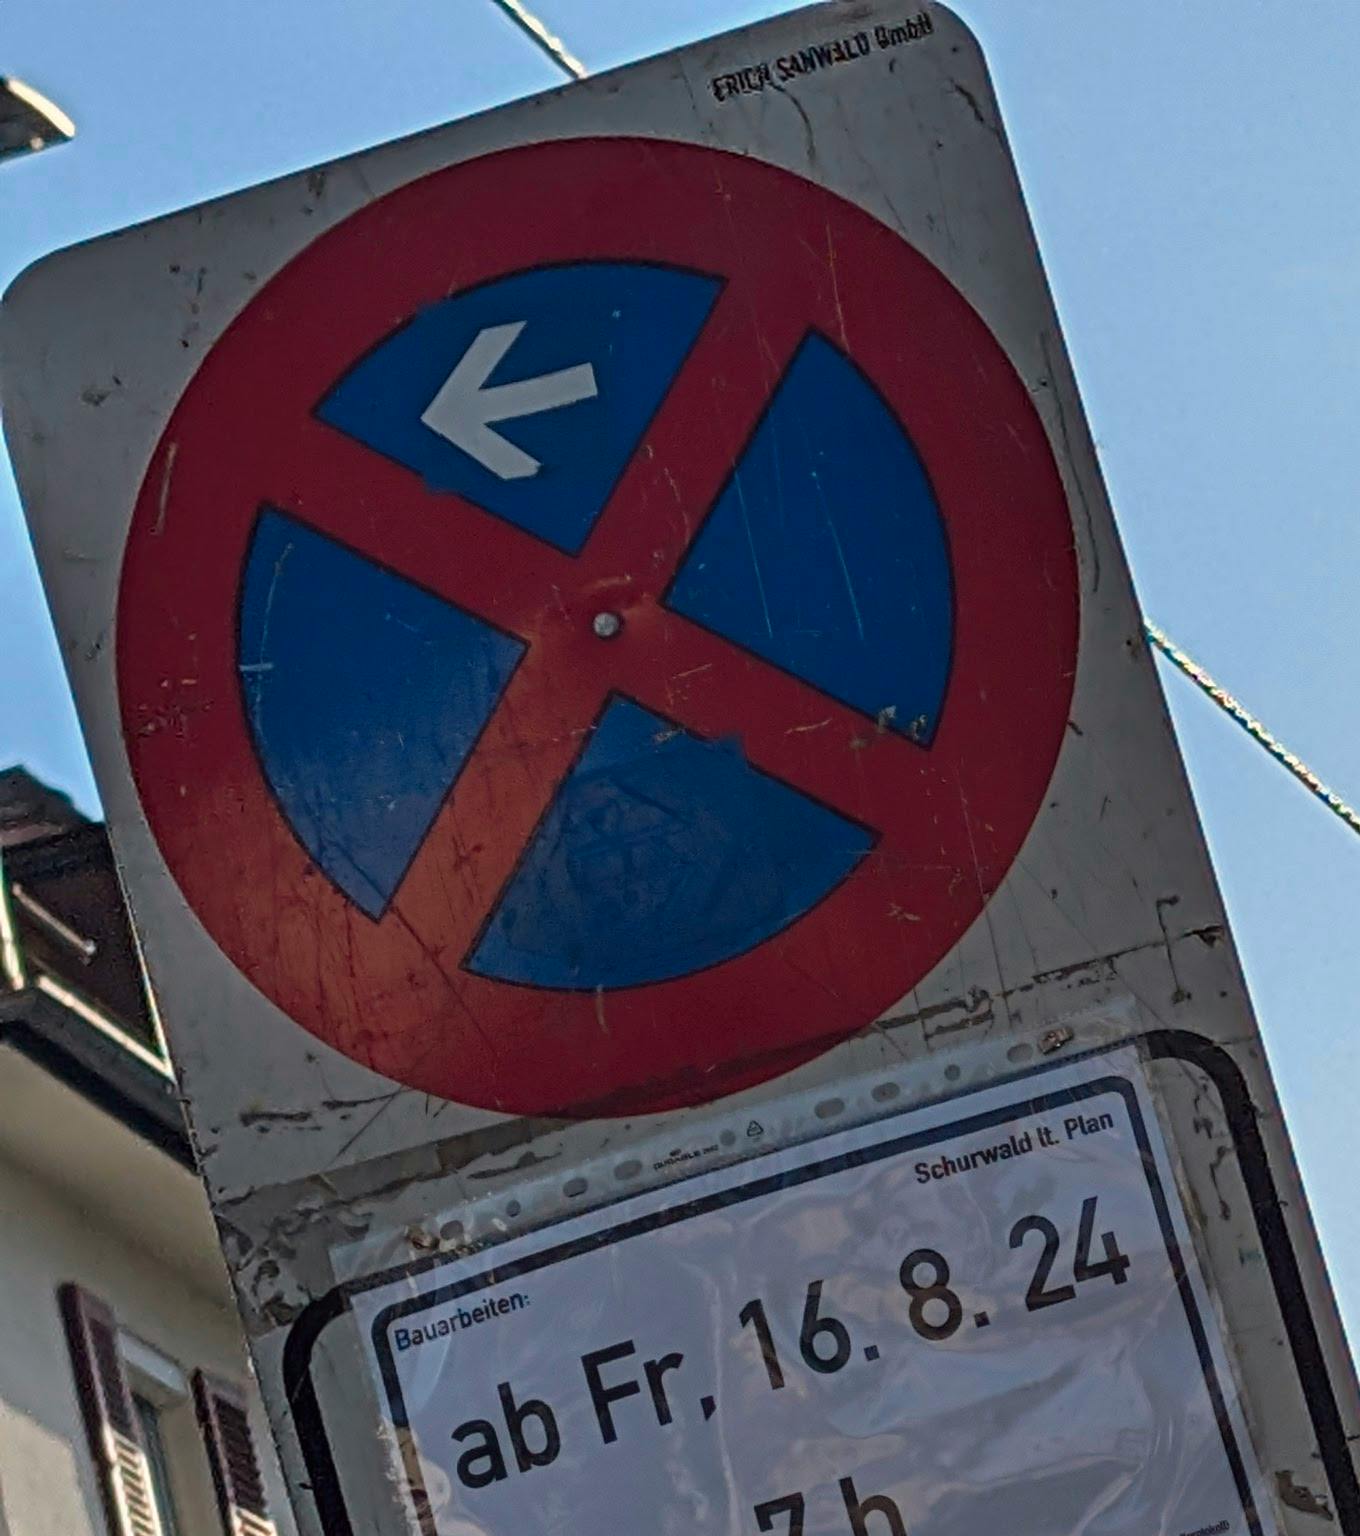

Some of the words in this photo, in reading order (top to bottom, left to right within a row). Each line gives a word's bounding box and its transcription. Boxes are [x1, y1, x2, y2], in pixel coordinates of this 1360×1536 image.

[712, 62, 771, 102] ERICH
[874, 10, 935, 50] GmbH
[914, 1131, 1033, 1184] Schurwald
[1063, 1113, 1115, 1140] Plan
[394, 1292, 531, 1351] Bauarbeiten:
[451, 1381, 561, 1490] ab
[1009, 1195, 1131, 1312] 24
